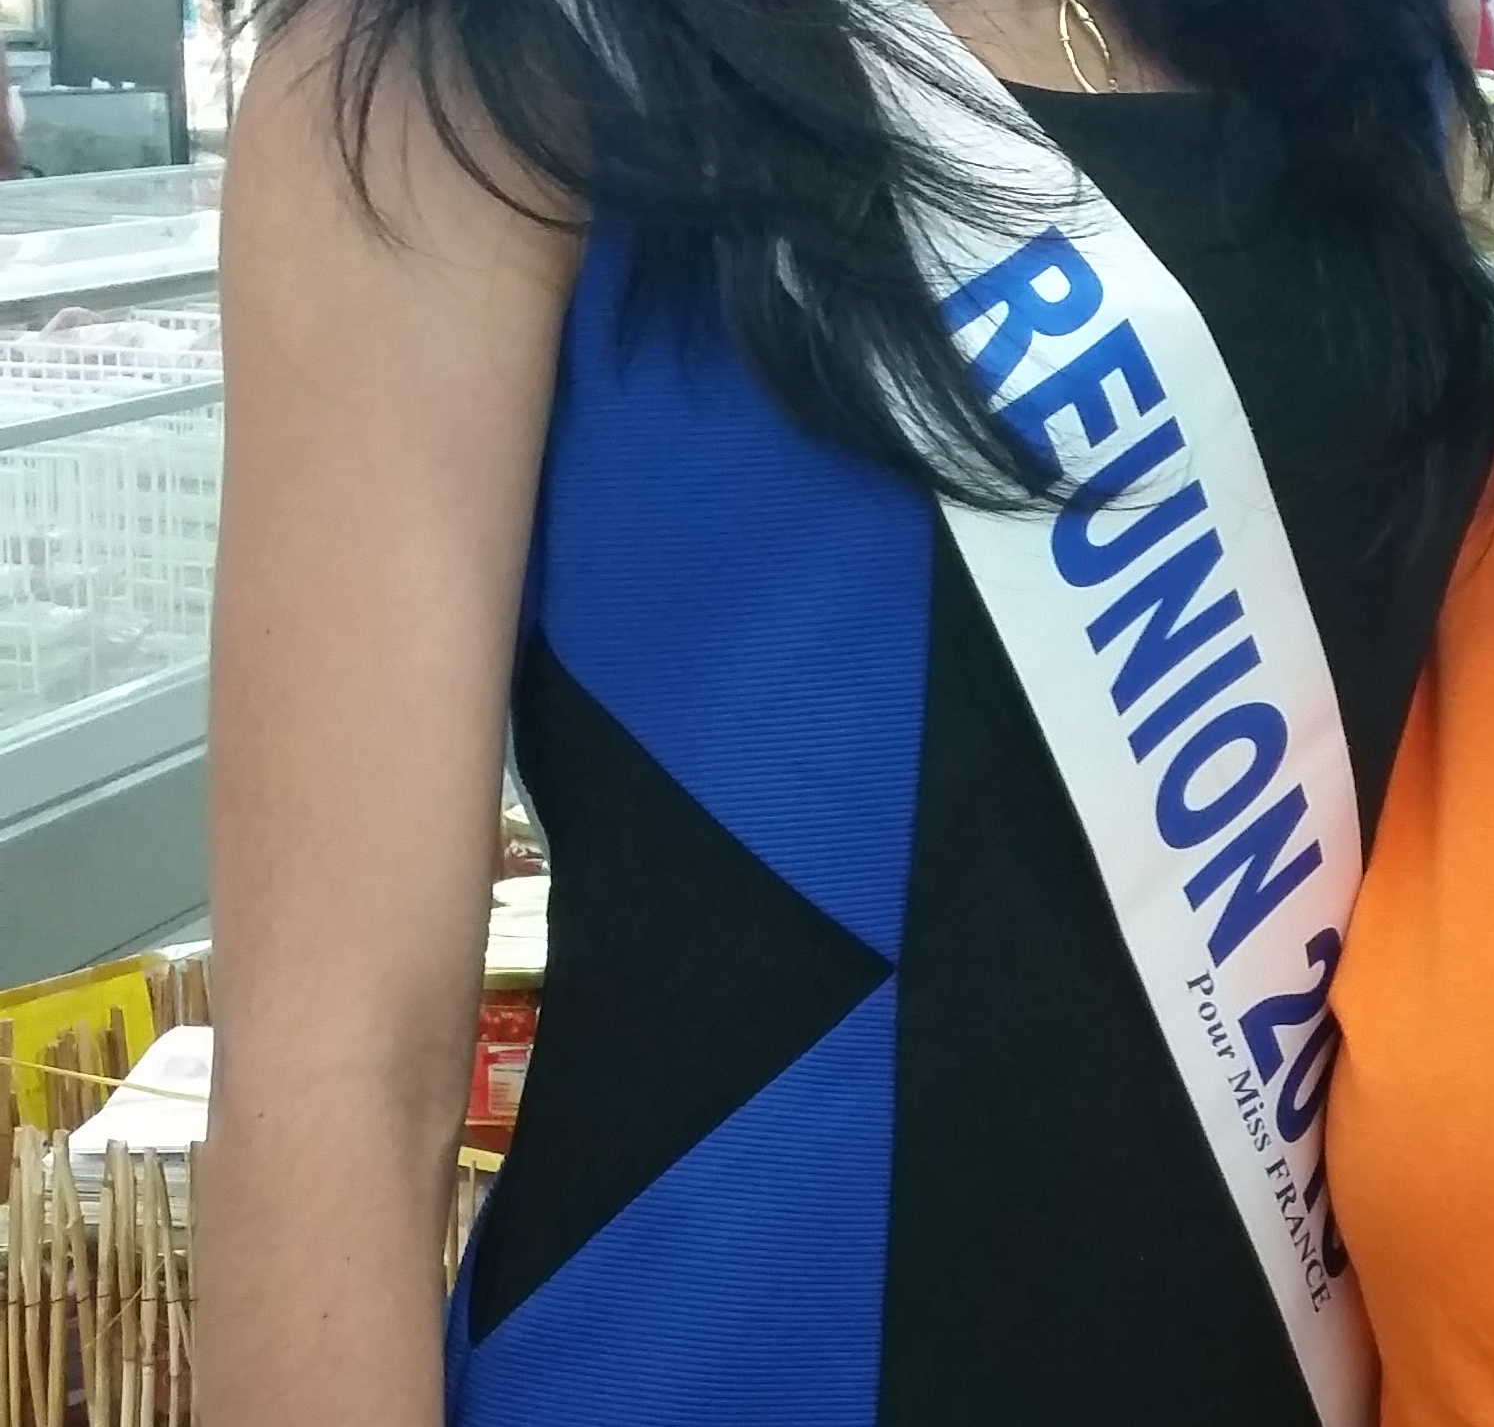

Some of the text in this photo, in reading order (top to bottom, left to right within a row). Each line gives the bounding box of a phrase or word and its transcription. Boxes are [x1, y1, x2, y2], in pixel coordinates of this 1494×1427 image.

[938, 223, 1351, 1280] REUNION 20
[1186, 969, 1332, 1314] Pour Miss FRANCE
